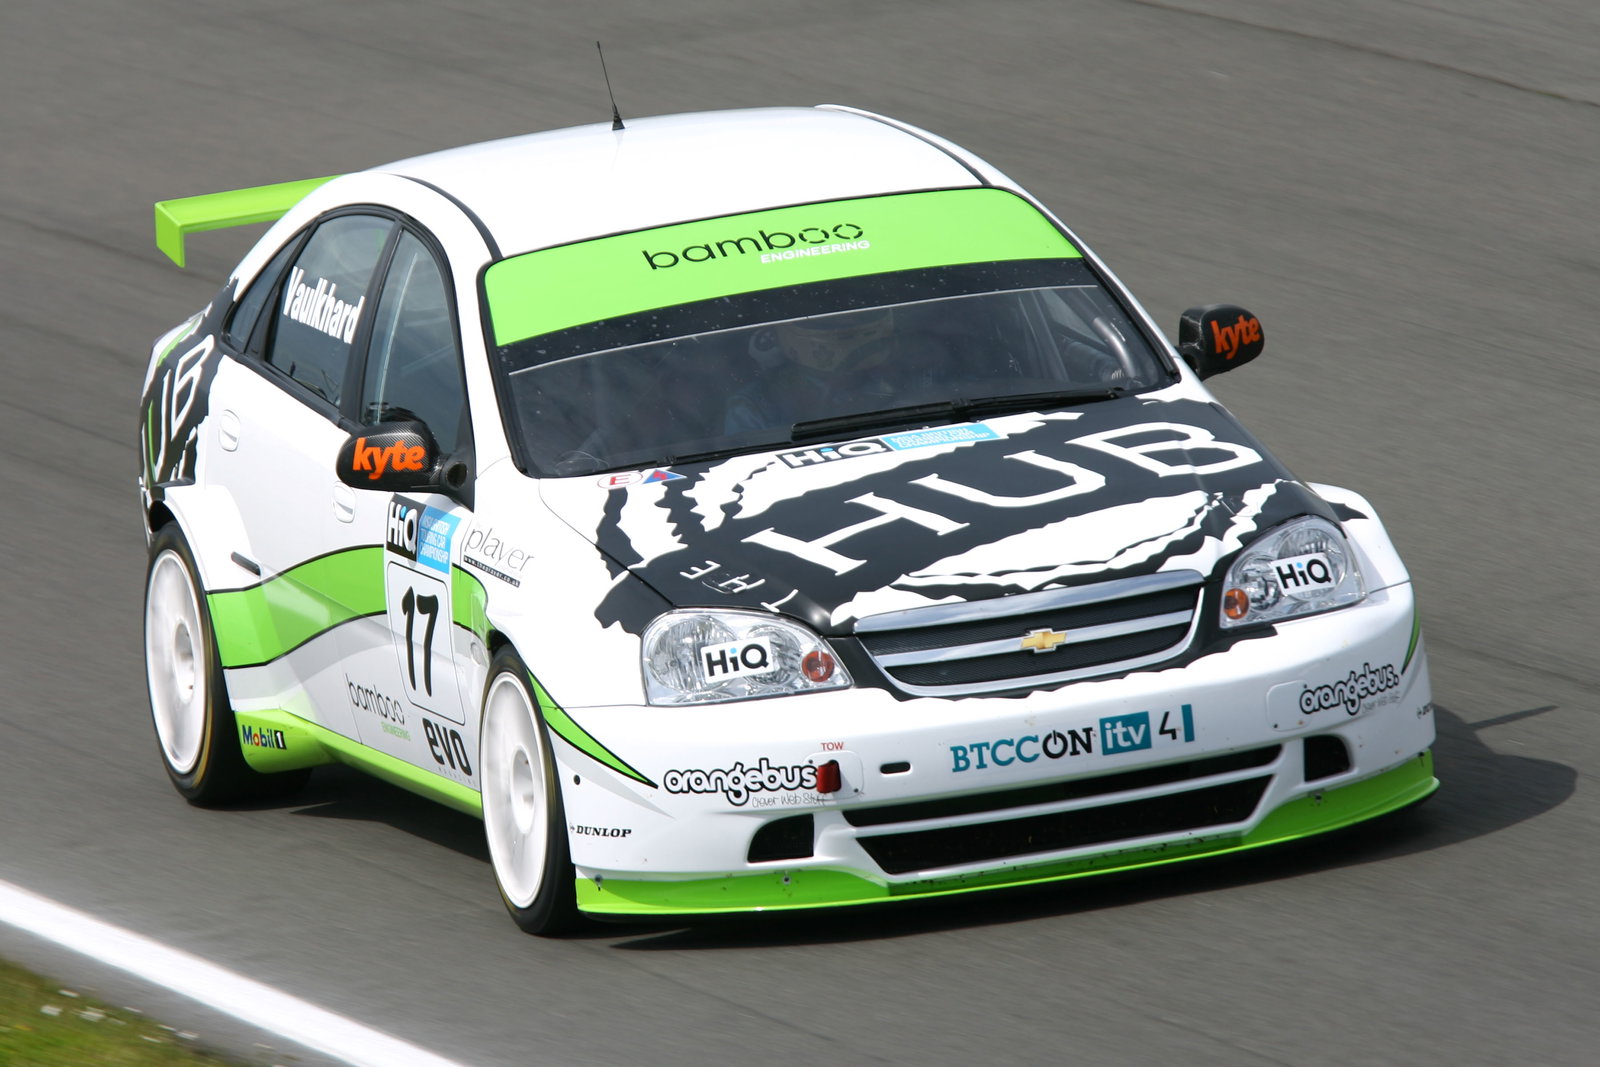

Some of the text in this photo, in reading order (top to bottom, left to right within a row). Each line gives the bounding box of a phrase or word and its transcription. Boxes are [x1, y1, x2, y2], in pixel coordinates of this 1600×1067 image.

[642, 223, 864, 270] bamboo
[760, 240, 871, 264] ENGINEERING
[282, 266, 366, 344] Vaulkhard
[1210, 314, 1261, 360] kyte
[352, 437, 426, 480] kyte
[782, 442, 887, 467] HiQ
[740, 421, 1263, 576] HUB
[387, 501, 418, 555] HiQ
[463, 528, 535, 572] player
[1275, 558, 1332, 589] HiQ
[402, 586, 439, 698] 17
[705, 643, 769, 677] HiQ
[345, 672, 405, 726] bamboo
[242, 724, 286, 749] Mobil 1
[422, 717, 472, 776] evo
[820, 741, 845, 751] TOW
[1105, 721, 1146, 750] itv
[576, 825, 632, 838] DUNLOP
